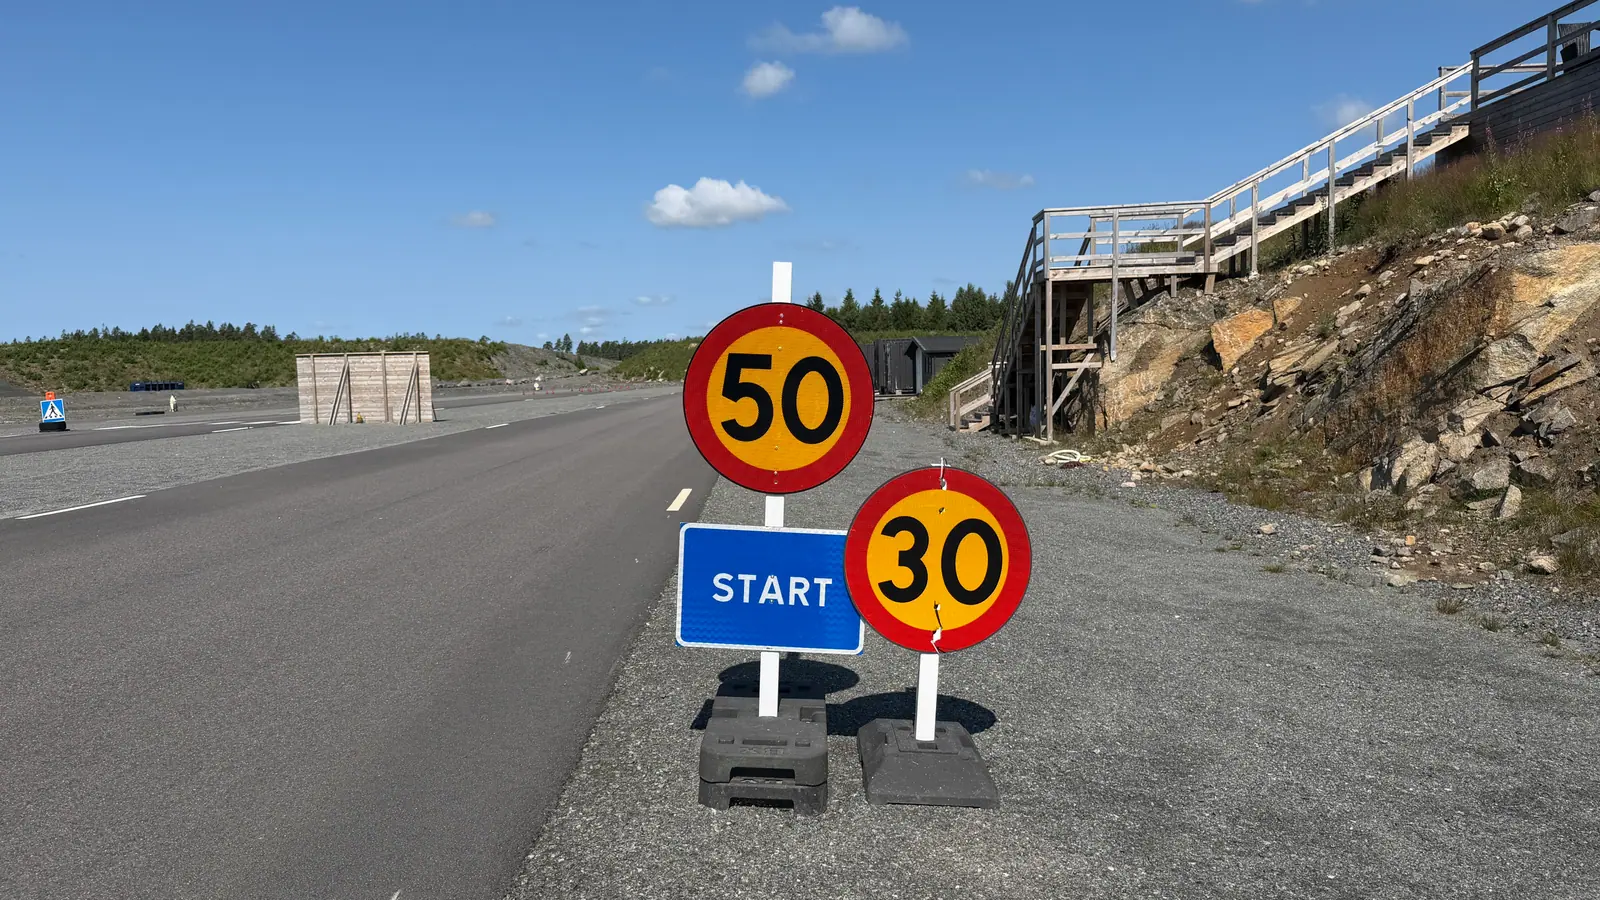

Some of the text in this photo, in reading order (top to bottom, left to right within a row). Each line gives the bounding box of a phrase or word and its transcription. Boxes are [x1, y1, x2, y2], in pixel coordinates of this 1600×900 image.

[721, 353, 844, 444] 50
[712, 573, 833, 607] START
[877, 516, 1003, 605] 30
